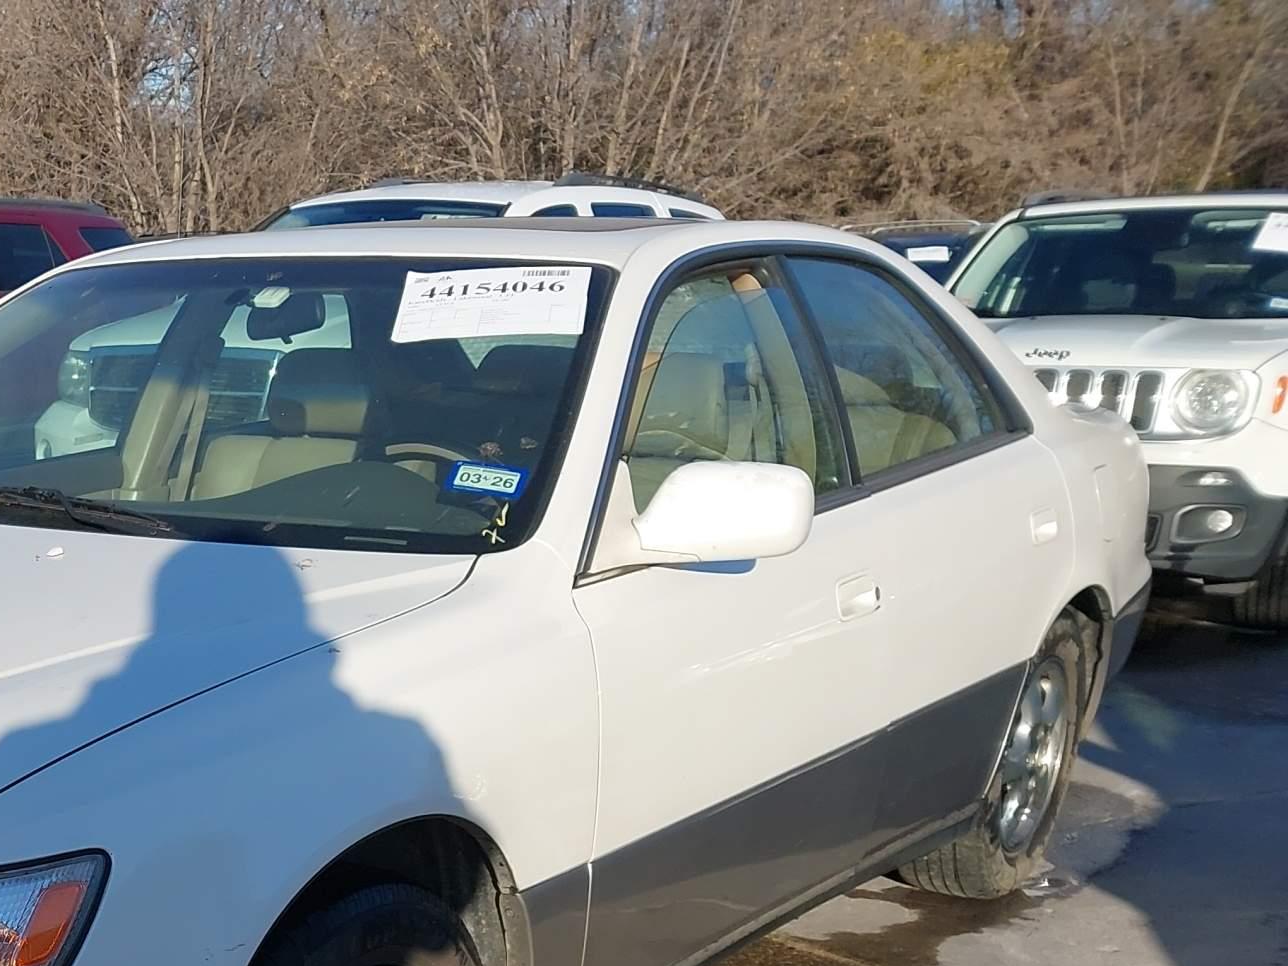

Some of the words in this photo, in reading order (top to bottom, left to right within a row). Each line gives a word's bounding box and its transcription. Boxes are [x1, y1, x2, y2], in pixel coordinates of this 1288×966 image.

[420, 279, 566, 300] 44154046
[1024, 347, 1071, 361] Jeep
[458, 471, 482, 484] 03
[490, 476, 515, 489] 26
